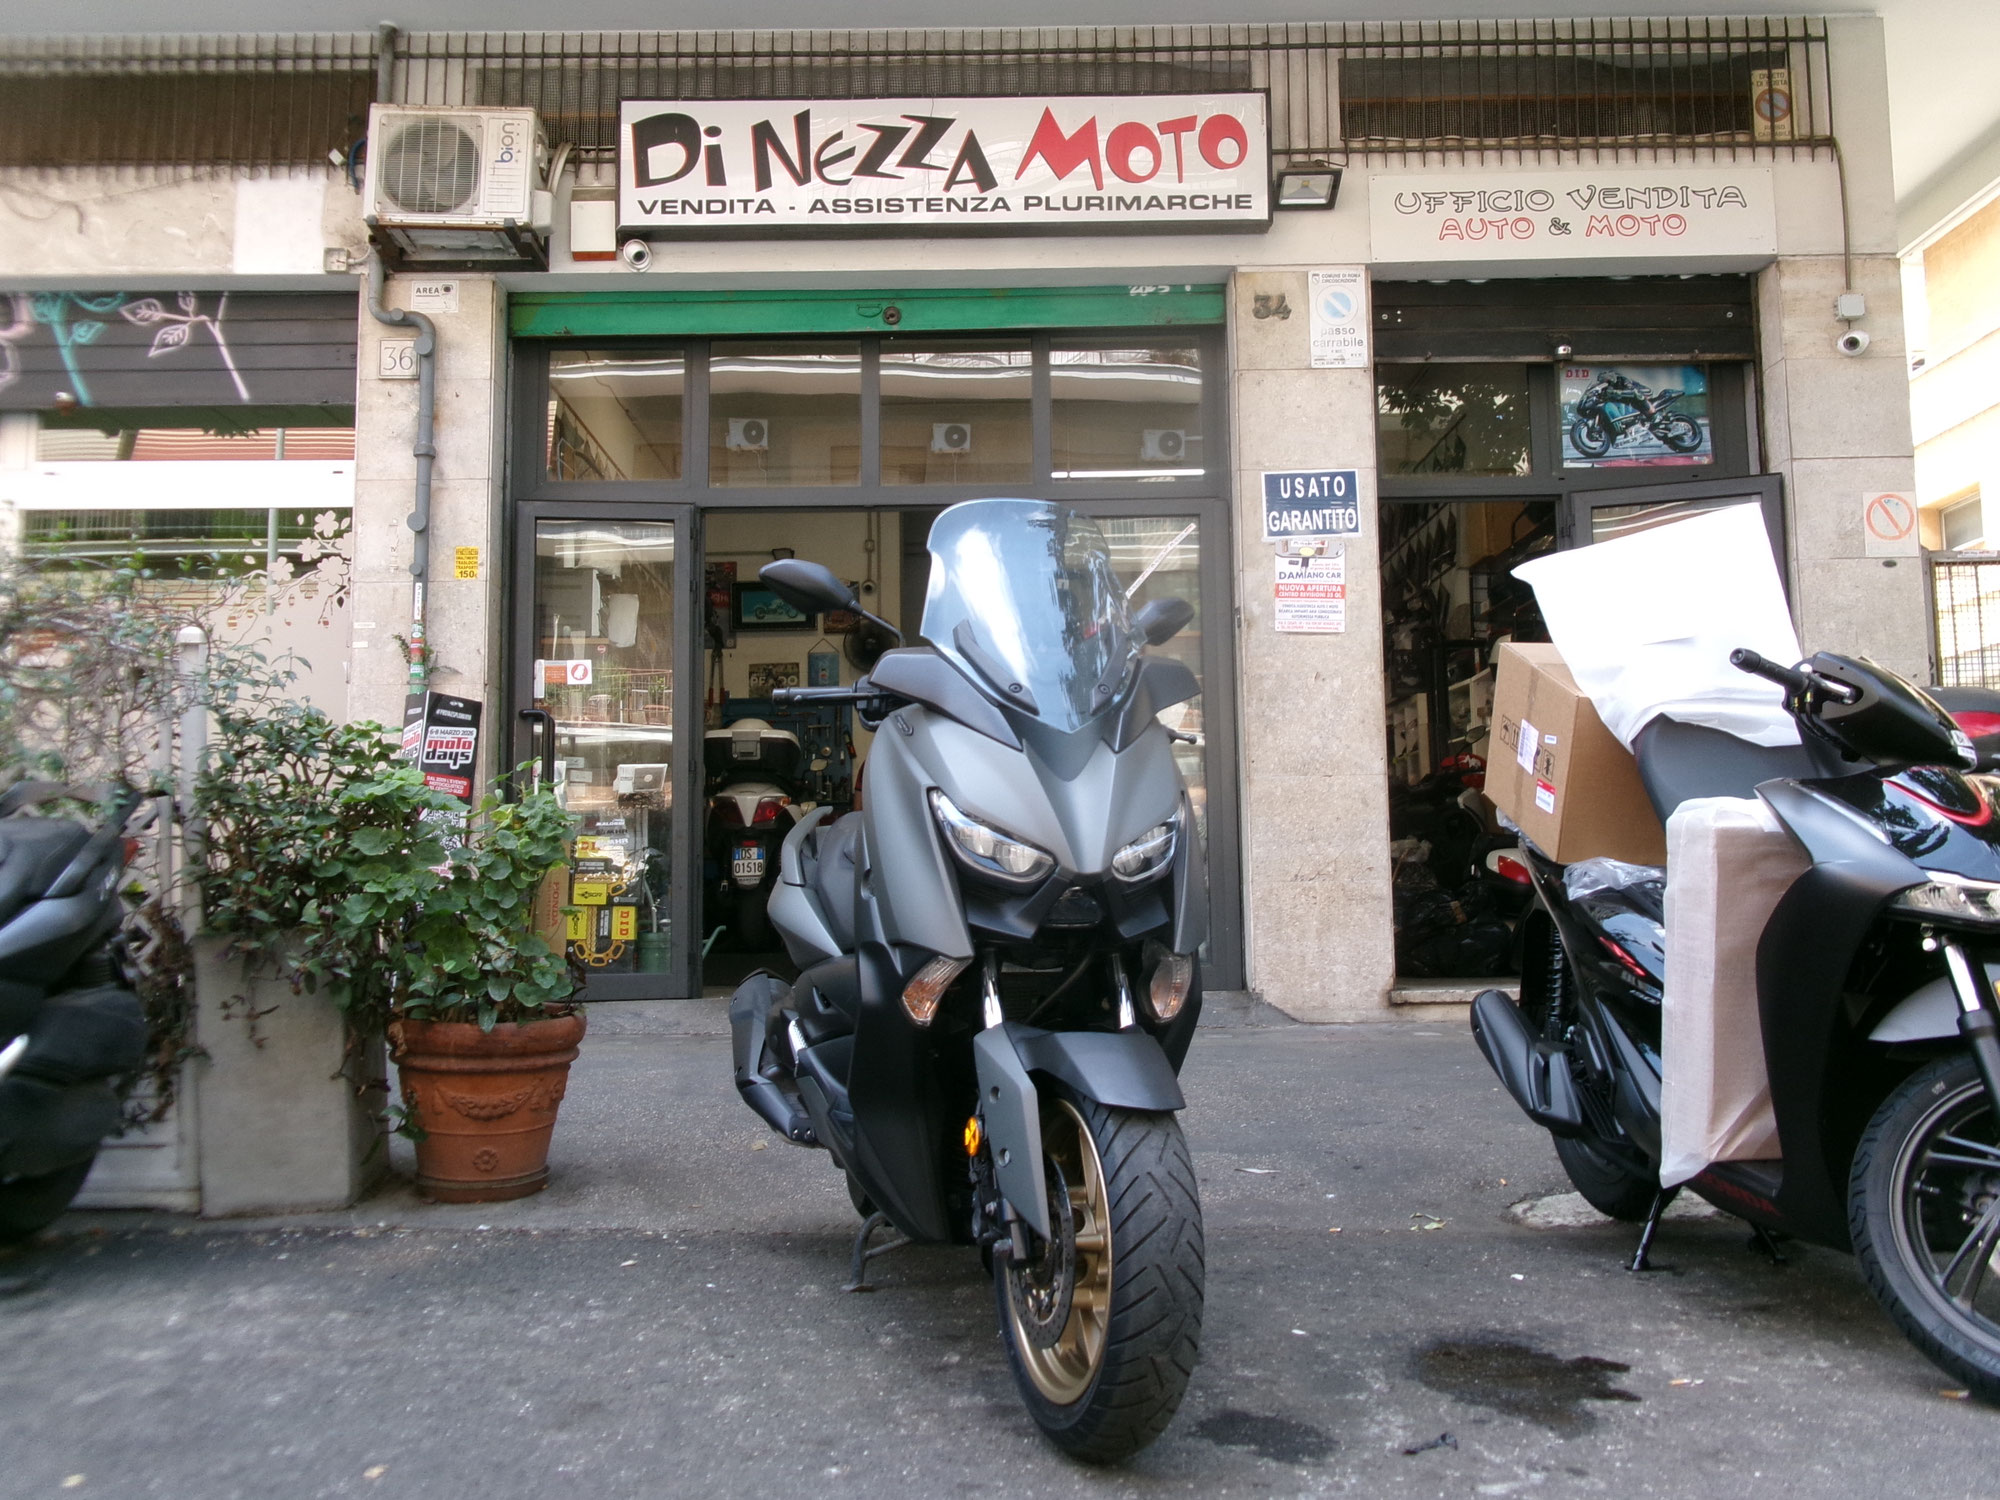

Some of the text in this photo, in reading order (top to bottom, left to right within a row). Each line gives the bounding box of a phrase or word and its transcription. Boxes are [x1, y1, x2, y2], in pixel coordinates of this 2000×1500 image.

[495, 121, 515, 163] bion
[631, 112, 727, 188] Di
[1014, 105, 1248, 191] MOTO
[637, 198, 777, 215] VENDITA
[808, 197, 1012, 215] ASSISTENZA
[1023, 194, 1252, 212] PLURIMARCHE
[1394, 184, 1747, 215] UFFICIO VENDITA
[1439, 213, 1687, 240] AUTO & MOTO
[1252, 294, 1292, 320] 34
[1313, 337, 1364, 347] carrabile
[1321, 327, 1356, 338] passo
[383, 346, 413, 370] 36
[1280, 475, 1346, 499] USATO
[1268, 508, 1357, 532] GARANTITO
[1279, 571, 1341, 580] DAMIANO CAR
[425, 748, 471, 767] days
[741, 848, 752, 859] DS
[734, 861, 763, 874] 01518
[619, 911, 630, 936] DID
